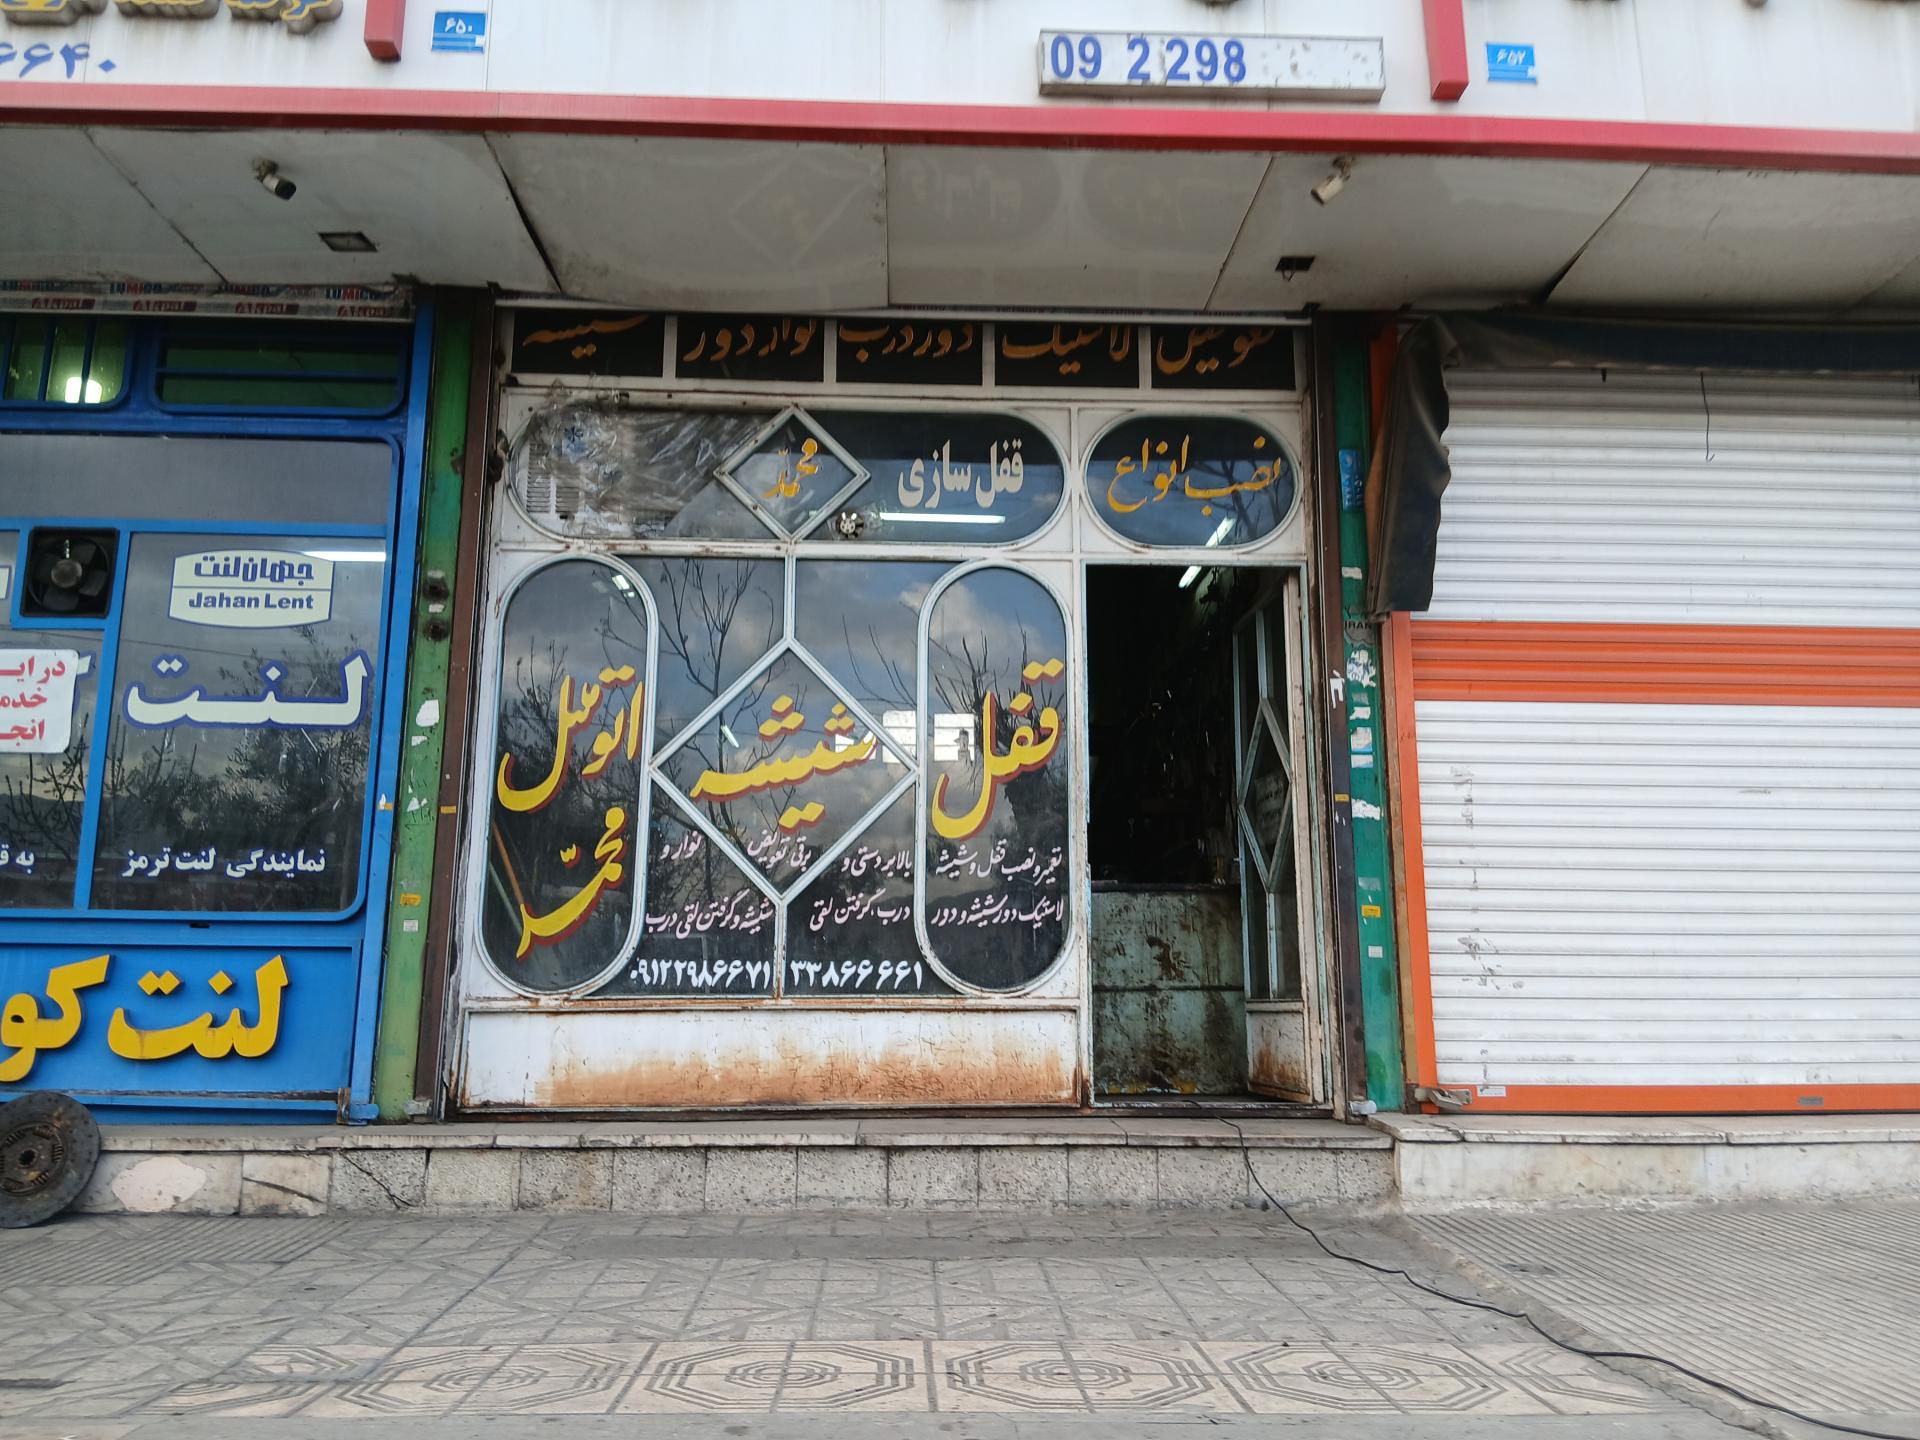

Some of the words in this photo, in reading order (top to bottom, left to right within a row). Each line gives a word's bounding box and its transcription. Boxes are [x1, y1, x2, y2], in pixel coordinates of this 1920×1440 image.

[1051, 35, 1101, 79] 09
[897, 439, 972, 509] سازی
[975, 437, 1024, 509] قفل
[1106, 433, 1191, 514] انواع
[1185, 435, 1282, 518] نصب
[188, 591, 260, 609] Jahan
[264, 592, 315, 610] Lent
[124, 648, 373, 730] لنت
[689, 693, 879, 834] شیشه
[931, 657, 1065, 841] قفل
[121, 846, 172, 878] ترمز
[175, 847, 216, 871] لنت
[226, 848, 326, 878] نمایندگی
[107, 954, 289, 1060] لنت
